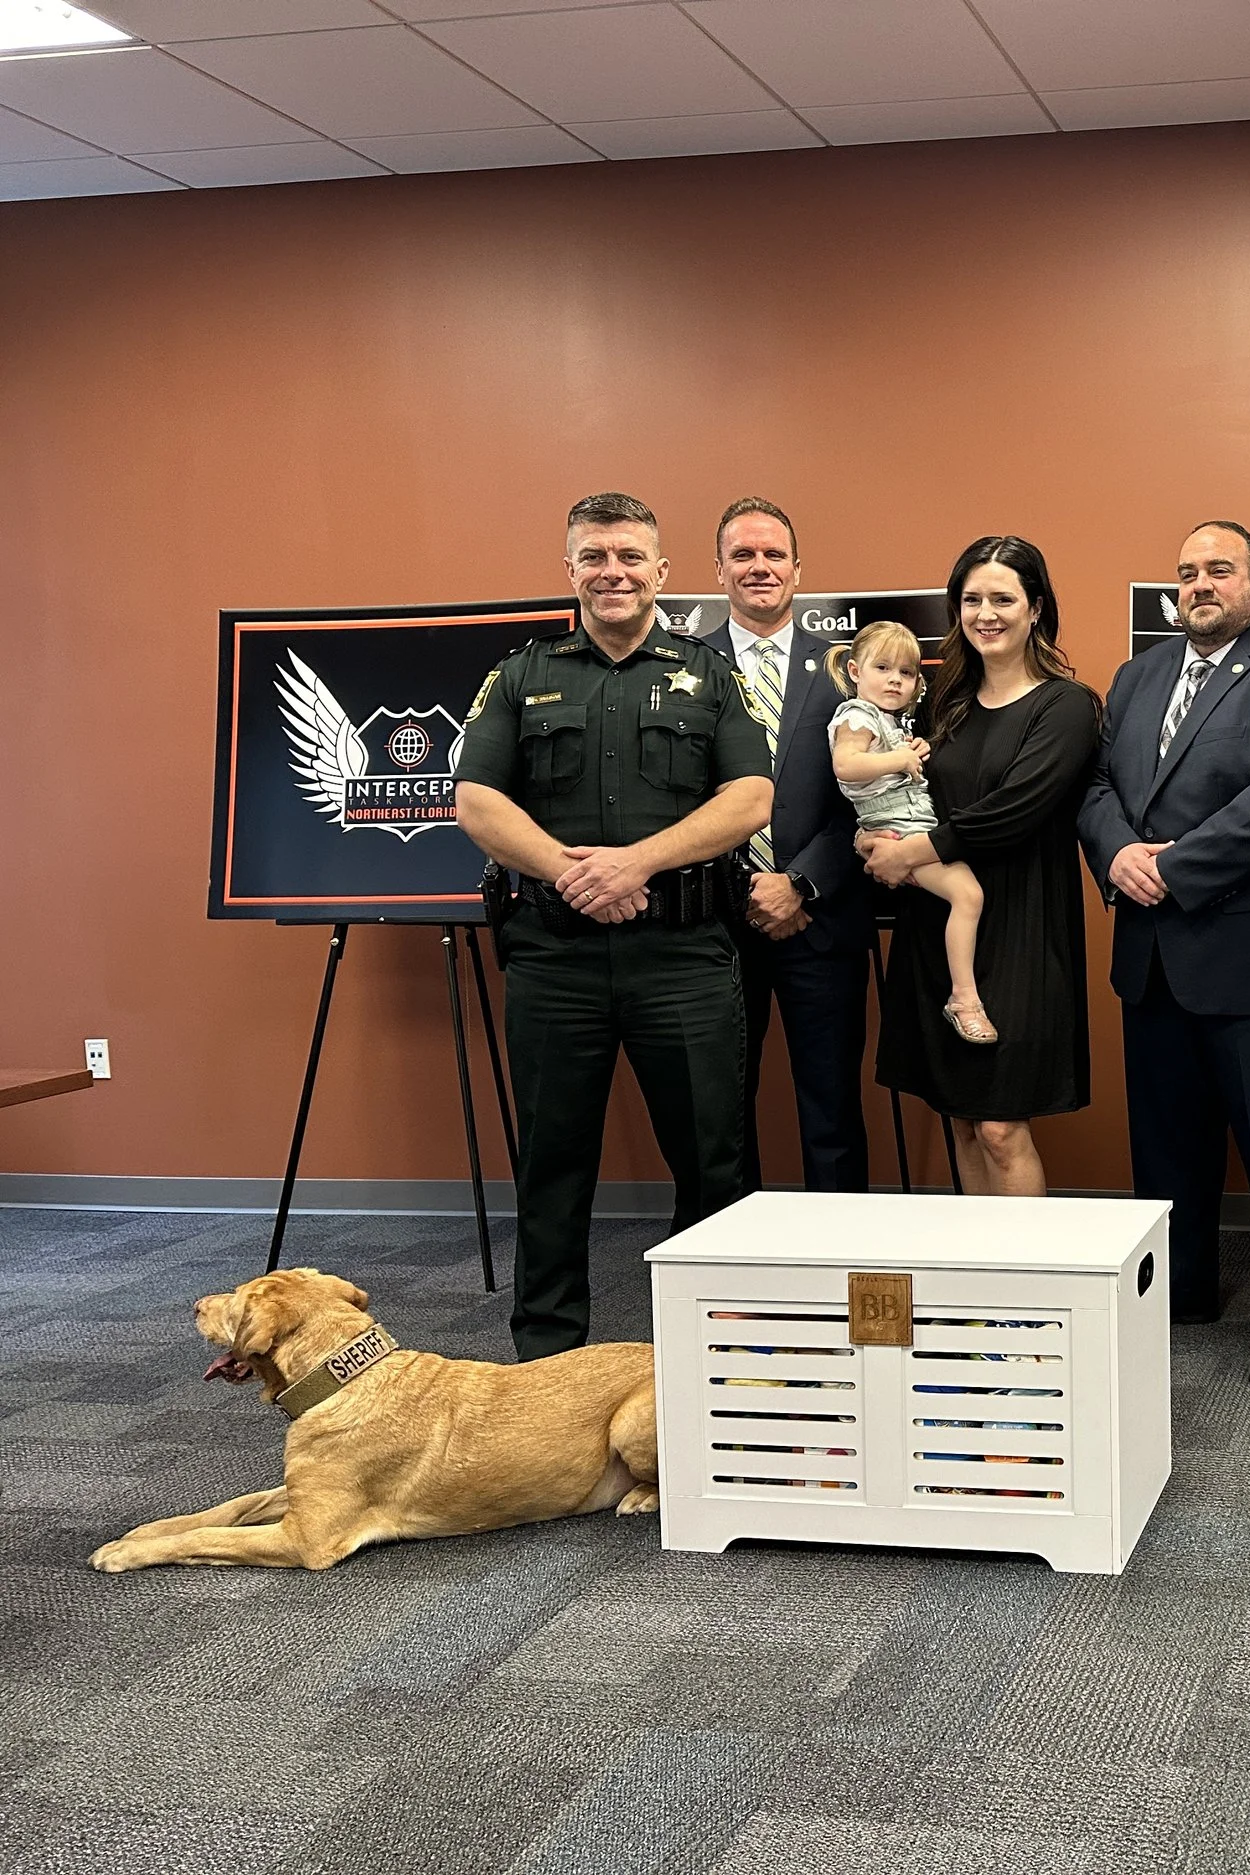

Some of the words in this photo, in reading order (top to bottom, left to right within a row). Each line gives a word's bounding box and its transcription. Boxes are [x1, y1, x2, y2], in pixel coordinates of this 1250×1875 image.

[801, 607, 858, 632] Goal
[348, 780, 454, 797] INTERCEP
[409, 796, 454, 804] FORC
[346, 807, 412, 820] NORTHEAST
[414, 806, 456, 819] FLORID
[331, 1331, 385, 1379] SHERIFF
